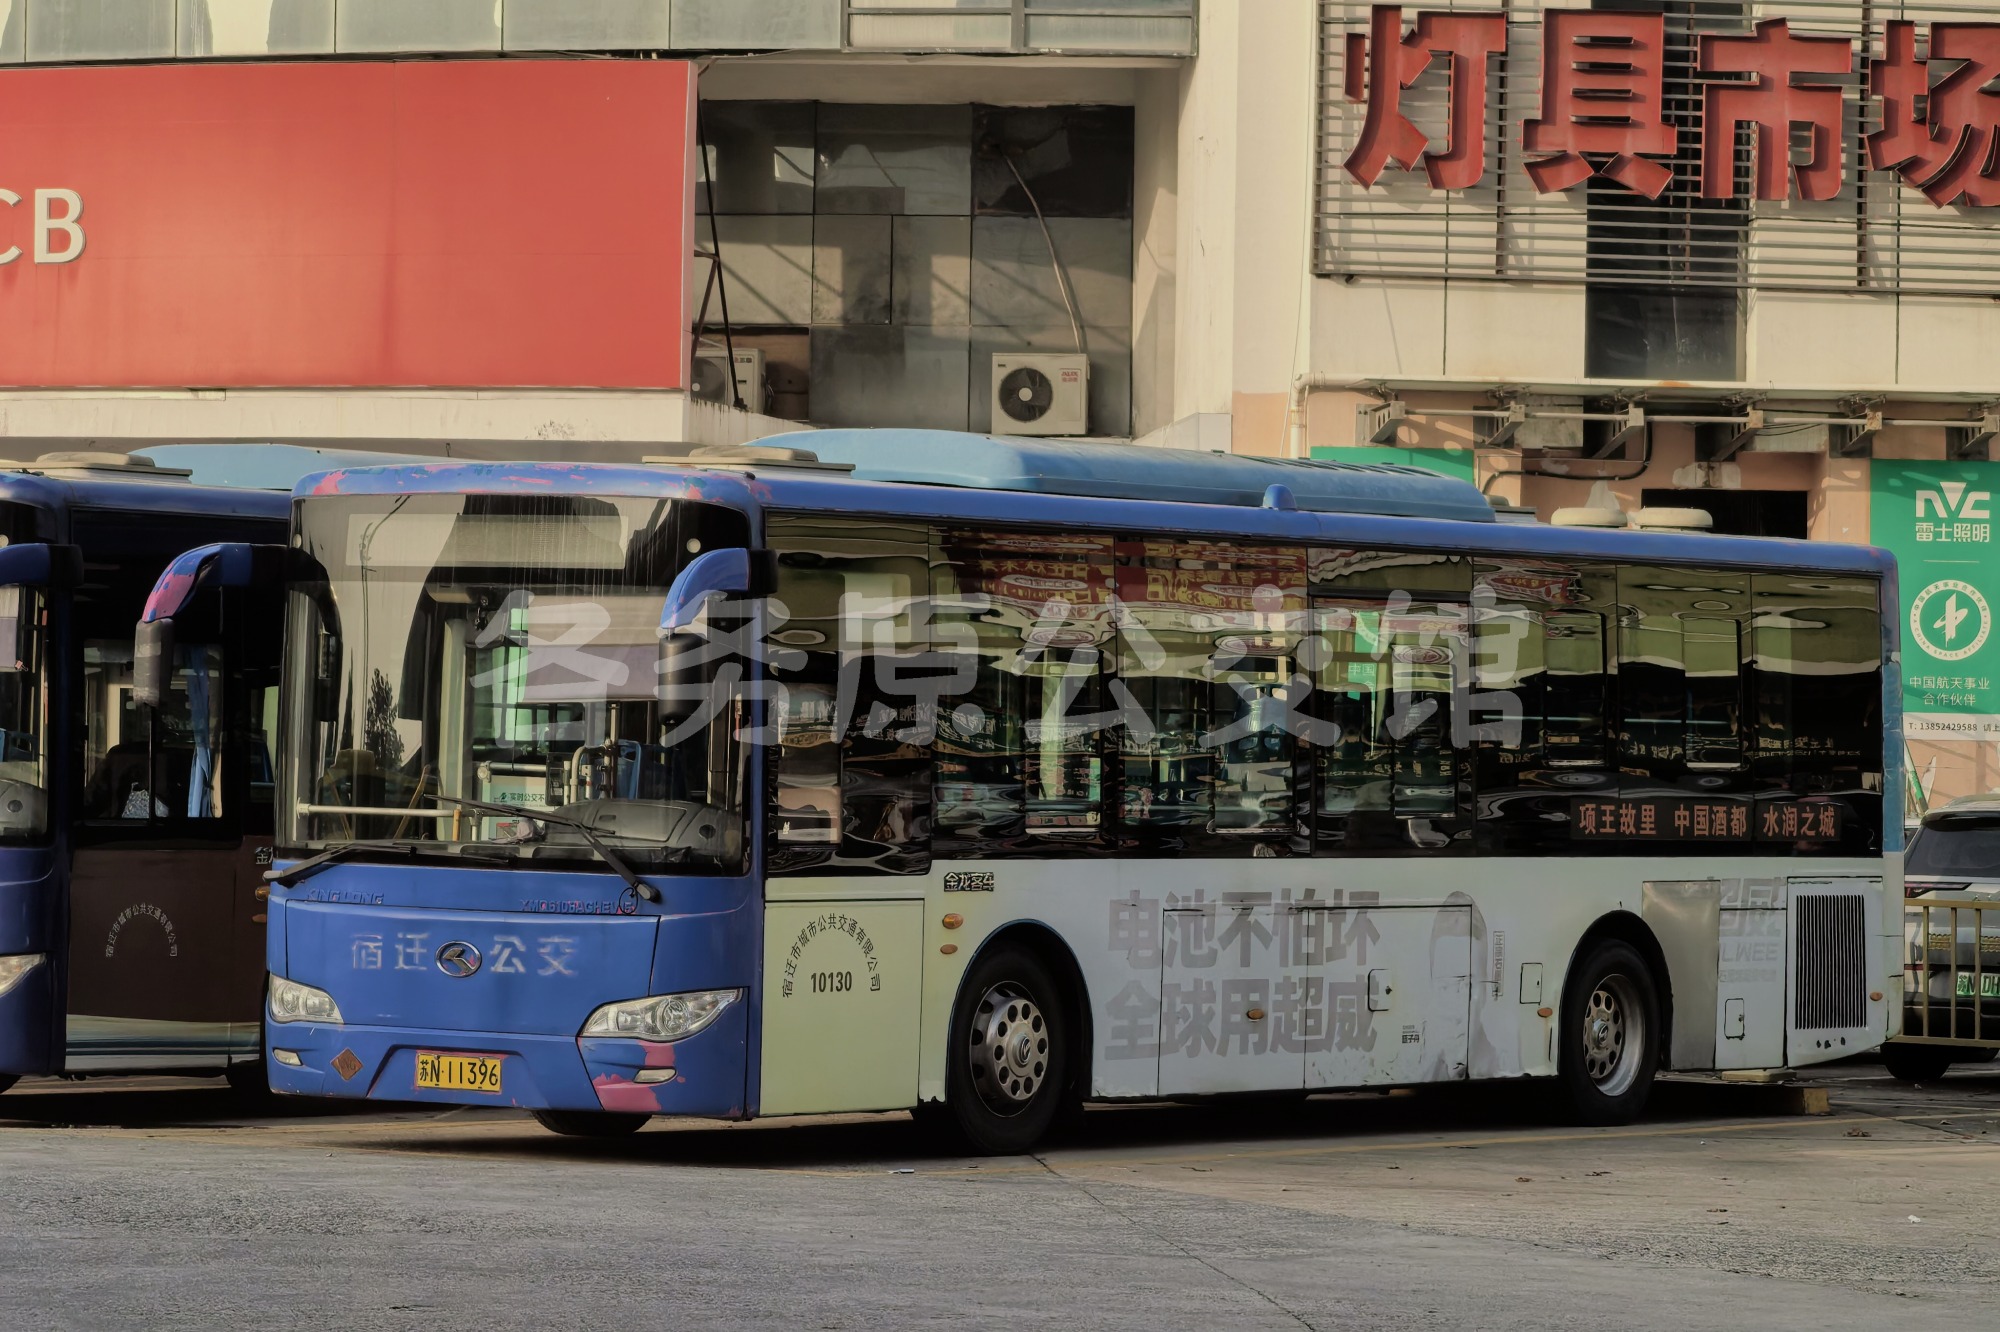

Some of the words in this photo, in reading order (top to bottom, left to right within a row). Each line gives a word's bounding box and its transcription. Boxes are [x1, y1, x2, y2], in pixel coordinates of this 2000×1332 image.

[1343, 4, 2000, 208] 灯具市场
[1915, 481, 1990, 518] NVC
[1915, 522, 1990, 542] 雷士照明
[1909, 675, 1990, 690] 中国航天事业
[1923, 692, 1976, 706] 合作伙伴
[1920, 722, 1978, 731] 13852429588
[1579, 803, 1657, 836] 项王故里
[1674, 804, 1747, 837] 中国酒都
[1763, 805, 1836, 837] 水润之城
[944, 872, 994, 892] 金龙客车
[1108, 888, 1381, 970] 电池不怕坏
[782, 912, 881, 998] 宿迁市城市公共交通有限公司
[810, 970, 852, 993] 10130
[1104, 974, 1380, 1060] 全球用超威
